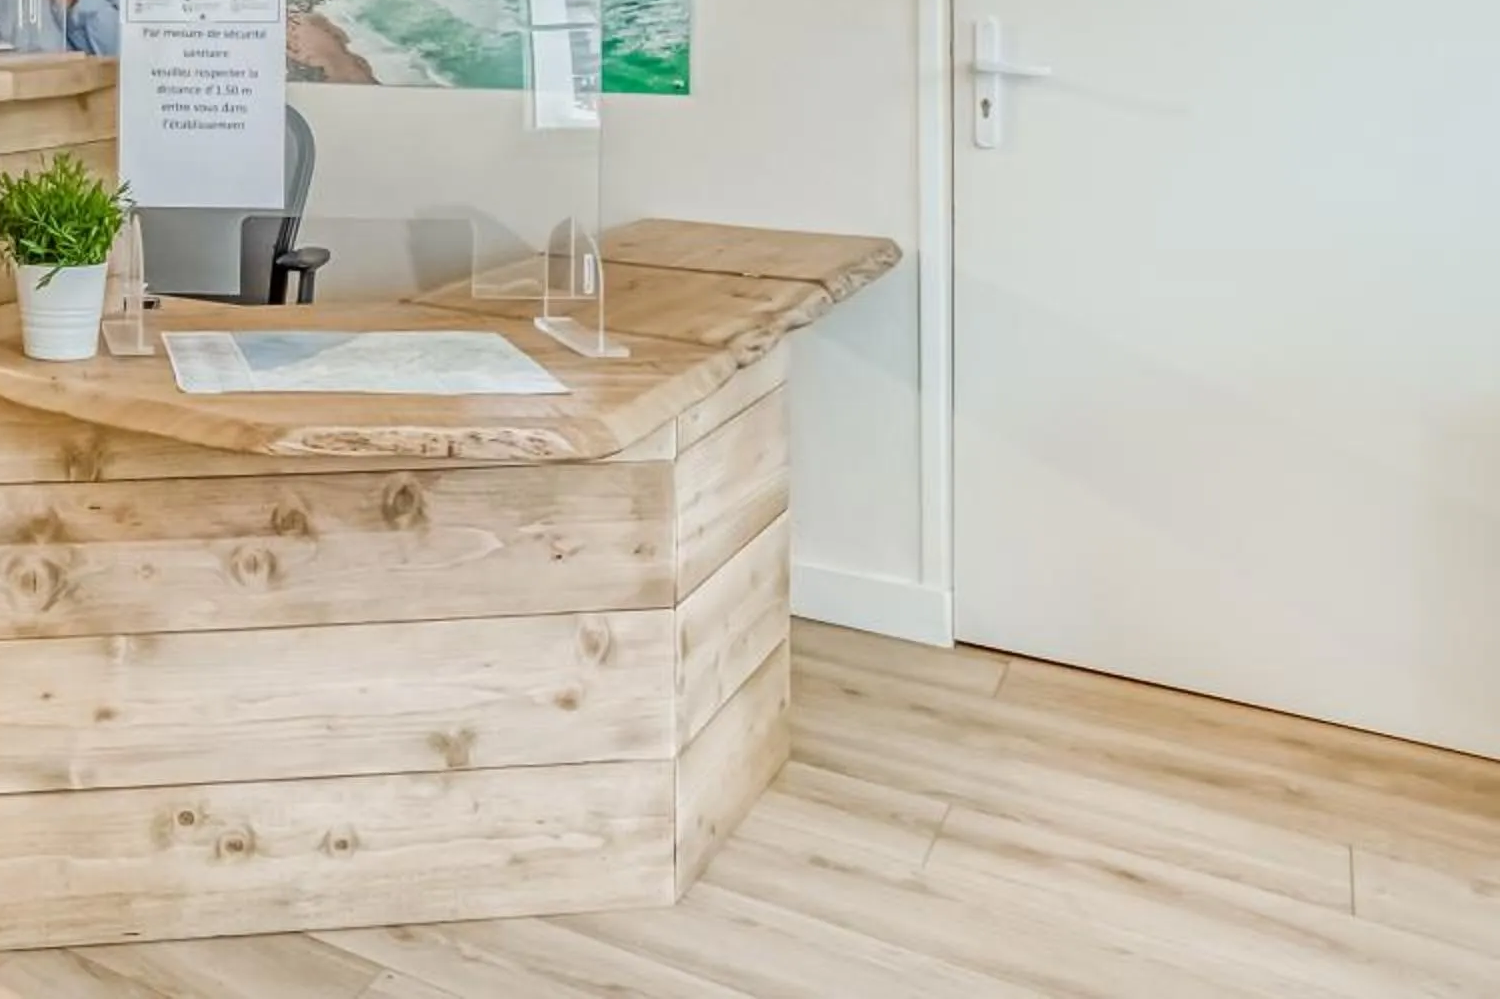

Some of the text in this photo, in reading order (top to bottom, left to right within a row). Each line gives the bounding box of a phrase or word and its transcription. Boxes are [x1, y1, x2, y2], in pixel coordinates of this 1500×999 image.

[143, 27, 160, 38] Par
[163, 29, 204, 39] mesure
[206, 29, 221, 39] de
[156, 84, 202, 95] distance
[161, 102, 248, 113] entre vous dans
